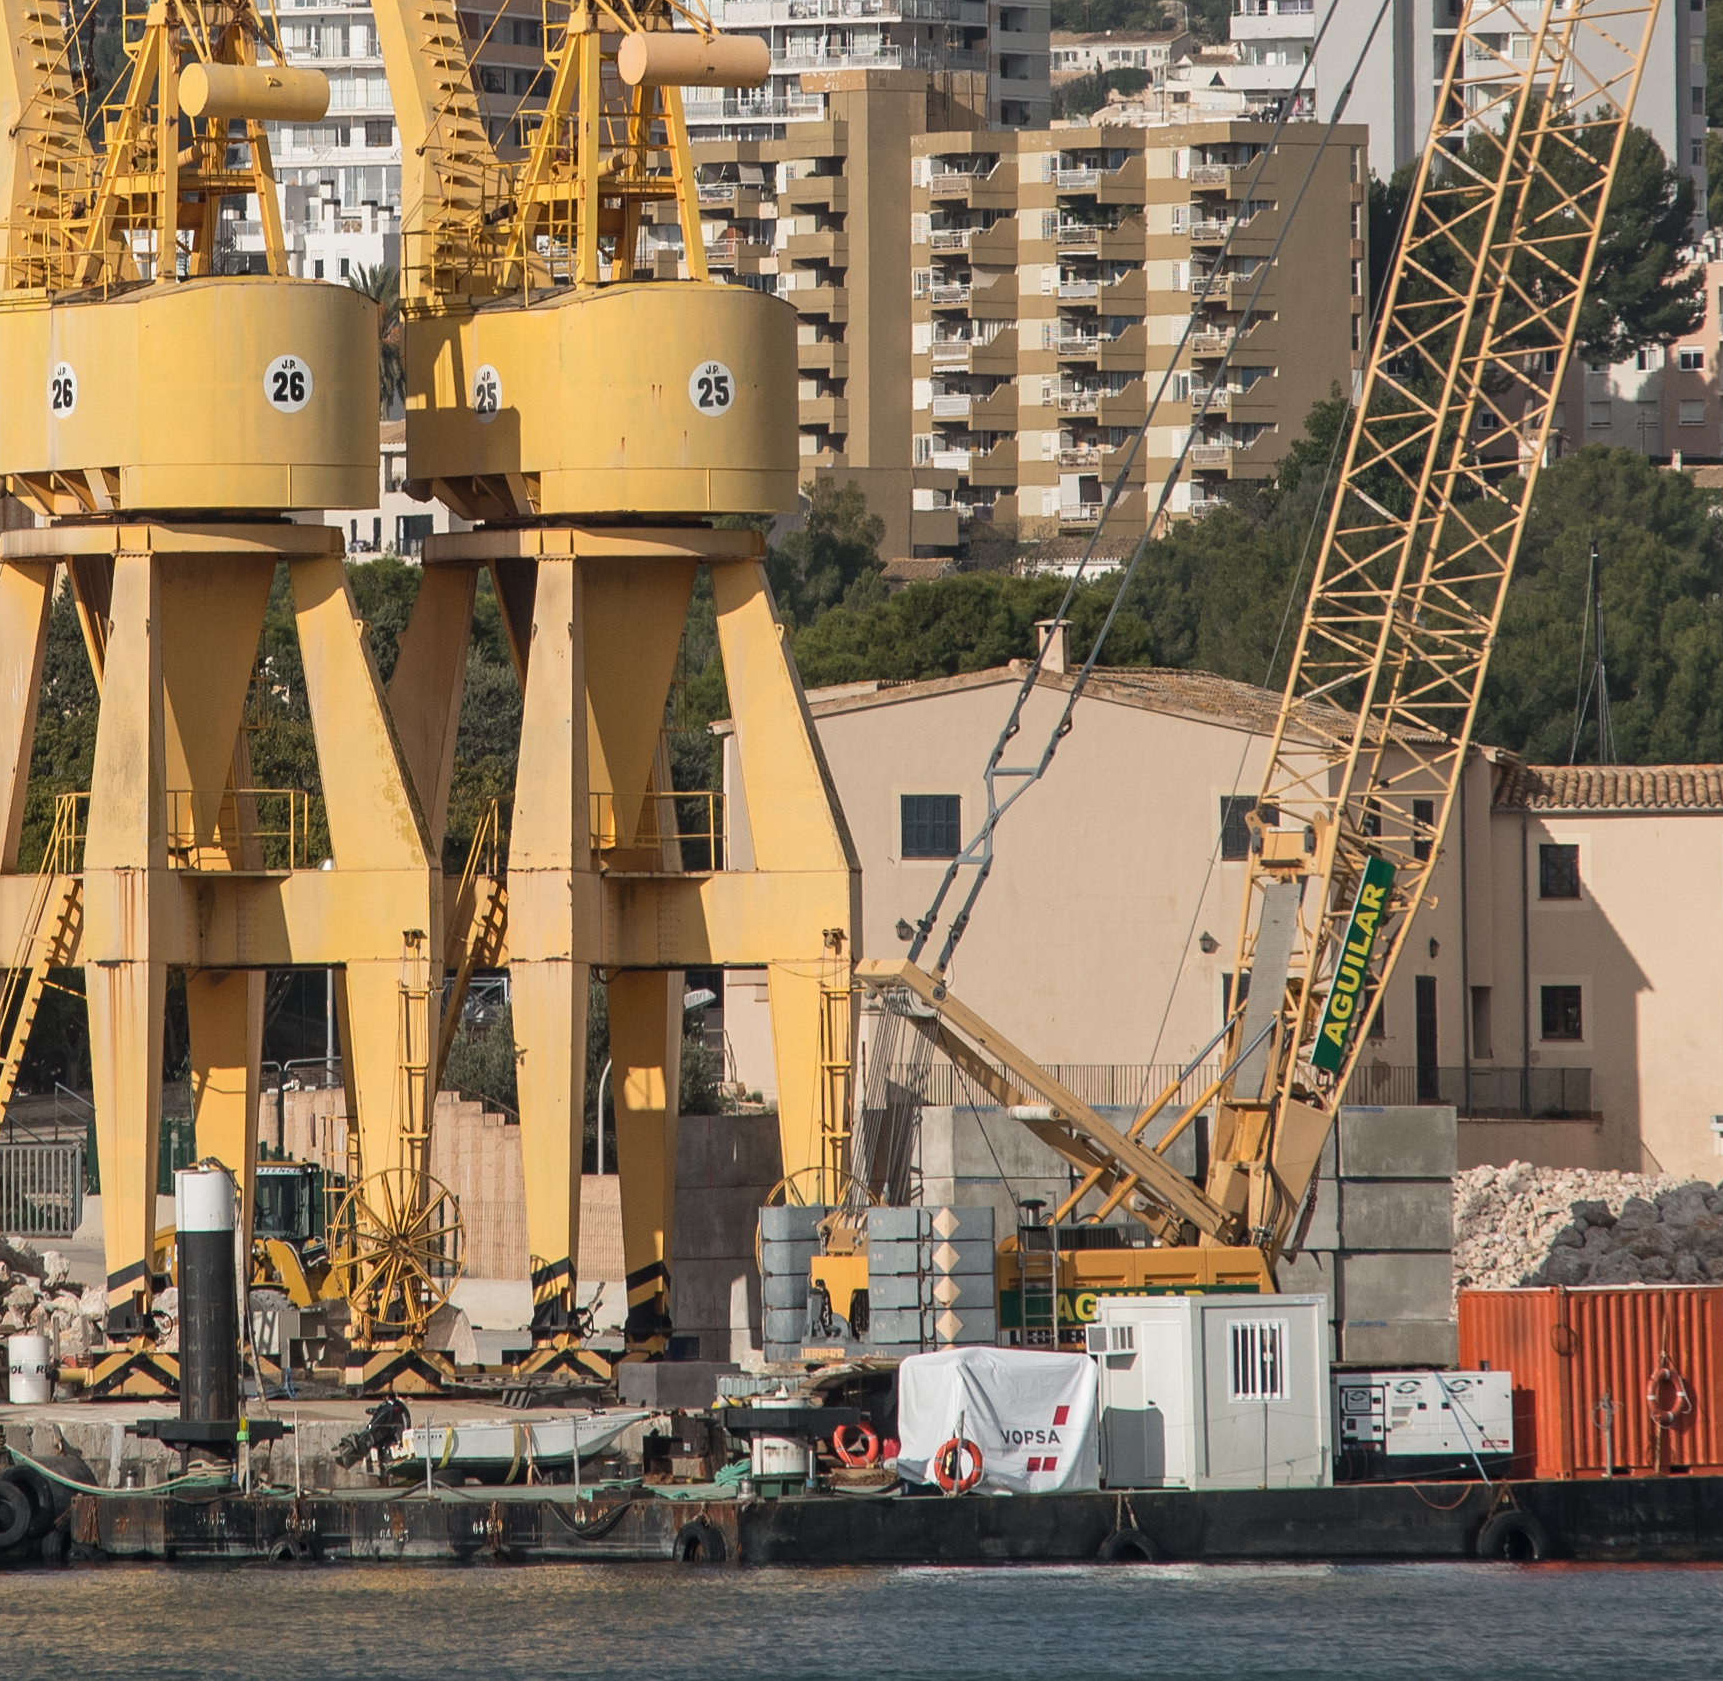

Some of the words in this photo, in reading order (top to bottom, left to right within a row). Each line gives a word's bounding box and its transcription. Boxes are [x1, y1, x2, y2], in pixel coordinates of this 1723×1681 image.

[52, 378, 73, 409] 26
[273, 371, 305, 402] 26
[476, 382, 498, 414] 25
[697, 375, 730, 408] 25
[1324, 883, 1386, 1048] AGUILAR
[1000, 1430, 1061, 1444] VOPSA
